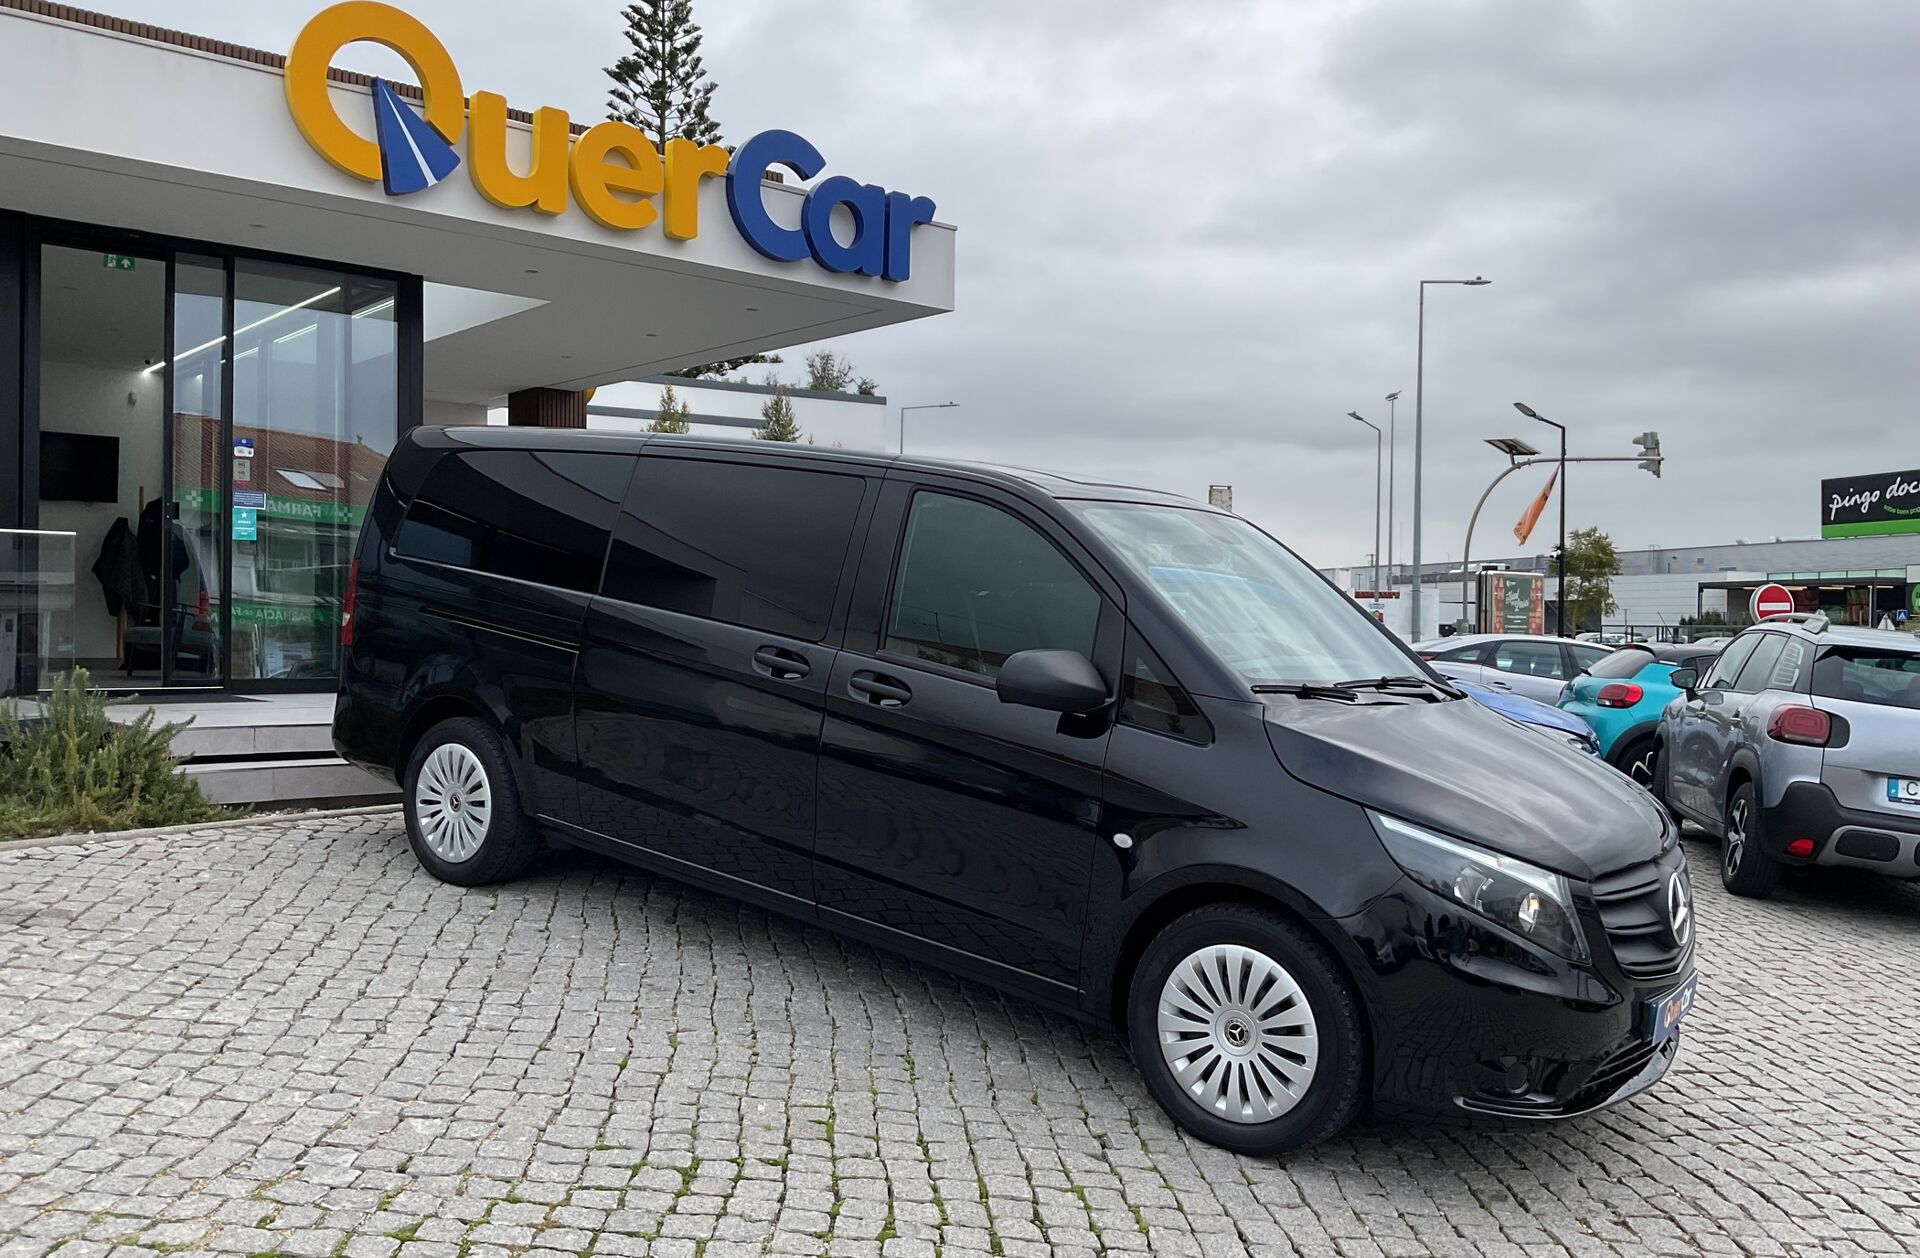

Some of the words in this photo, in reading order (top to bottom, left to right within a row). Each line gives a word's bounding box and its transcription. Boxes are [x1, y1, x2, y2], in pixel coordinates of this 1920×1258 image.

[285, 0, 936, 281] QuerCar
[1829, 488, 1881, 521] pingo
[1885, 476, 1920, 499] doc
